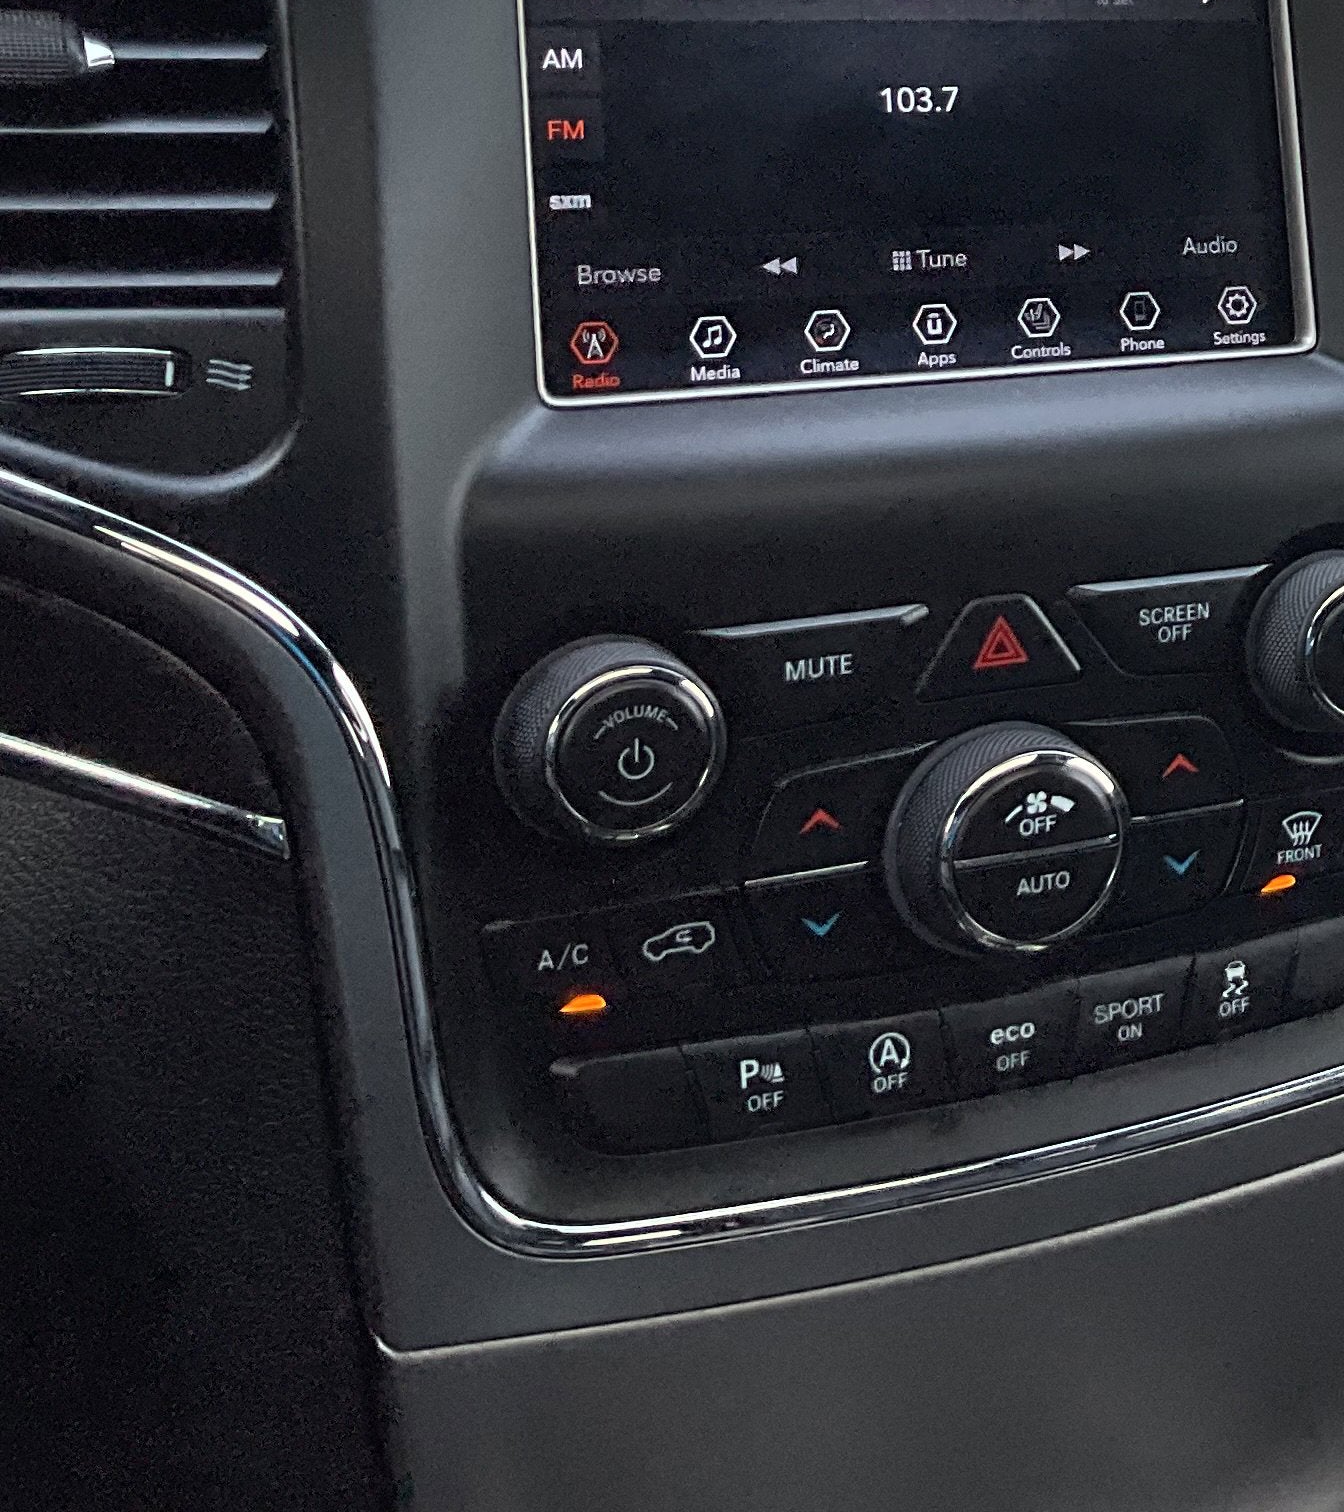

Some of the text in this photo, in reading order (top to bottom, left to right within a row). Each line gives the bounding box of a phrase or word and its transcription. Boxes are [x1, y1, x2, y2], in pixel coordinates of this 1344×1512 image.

[542, 48, 583, 70] AM
[879, 85, 960, 114] 103.7
[547, 119, 585, 141] FM
[1182, 235, 1238, 256] Audio
[915, 249, 967, 269] Tune
[577, 264, 662, 286] Browse
[1120, 336, 1165, 353] Phone
[1213, 330, 1266, 346] Settings
[917, 351, 957, 369] Apps
[1011, 343, 1071, 361] Controls
[691, 364, 741, 382] Media
[800, 357, 860, 375] Climate
[572, 373, 621, 390] Radio
[1138, 602, 1210, 627] SCREEN
[1157, 623, 1193, 643] OFF
[785, 653, 853, 682] MUTE
[602, 704, 668, 729] VOLUME
[1018, 814, 1057, 837] OFF
[1277, 843, 1322, 865] FRONT
[1016, 870, 1071, 896] AUTO
[537, 943, 589, 972] A/C
[1093, 993, 1165, 1025] SPORT
[1218, 996, 1250, 1018] OFF
[989, 1021, 1036, 1045] eco
[1117, 1022, 1143, 1042] ON
[996, 1049, 1032, 1072] OFF
[872, 1071, 909, 1093] OFF
[747, 1090, 784, 1113] OFF
